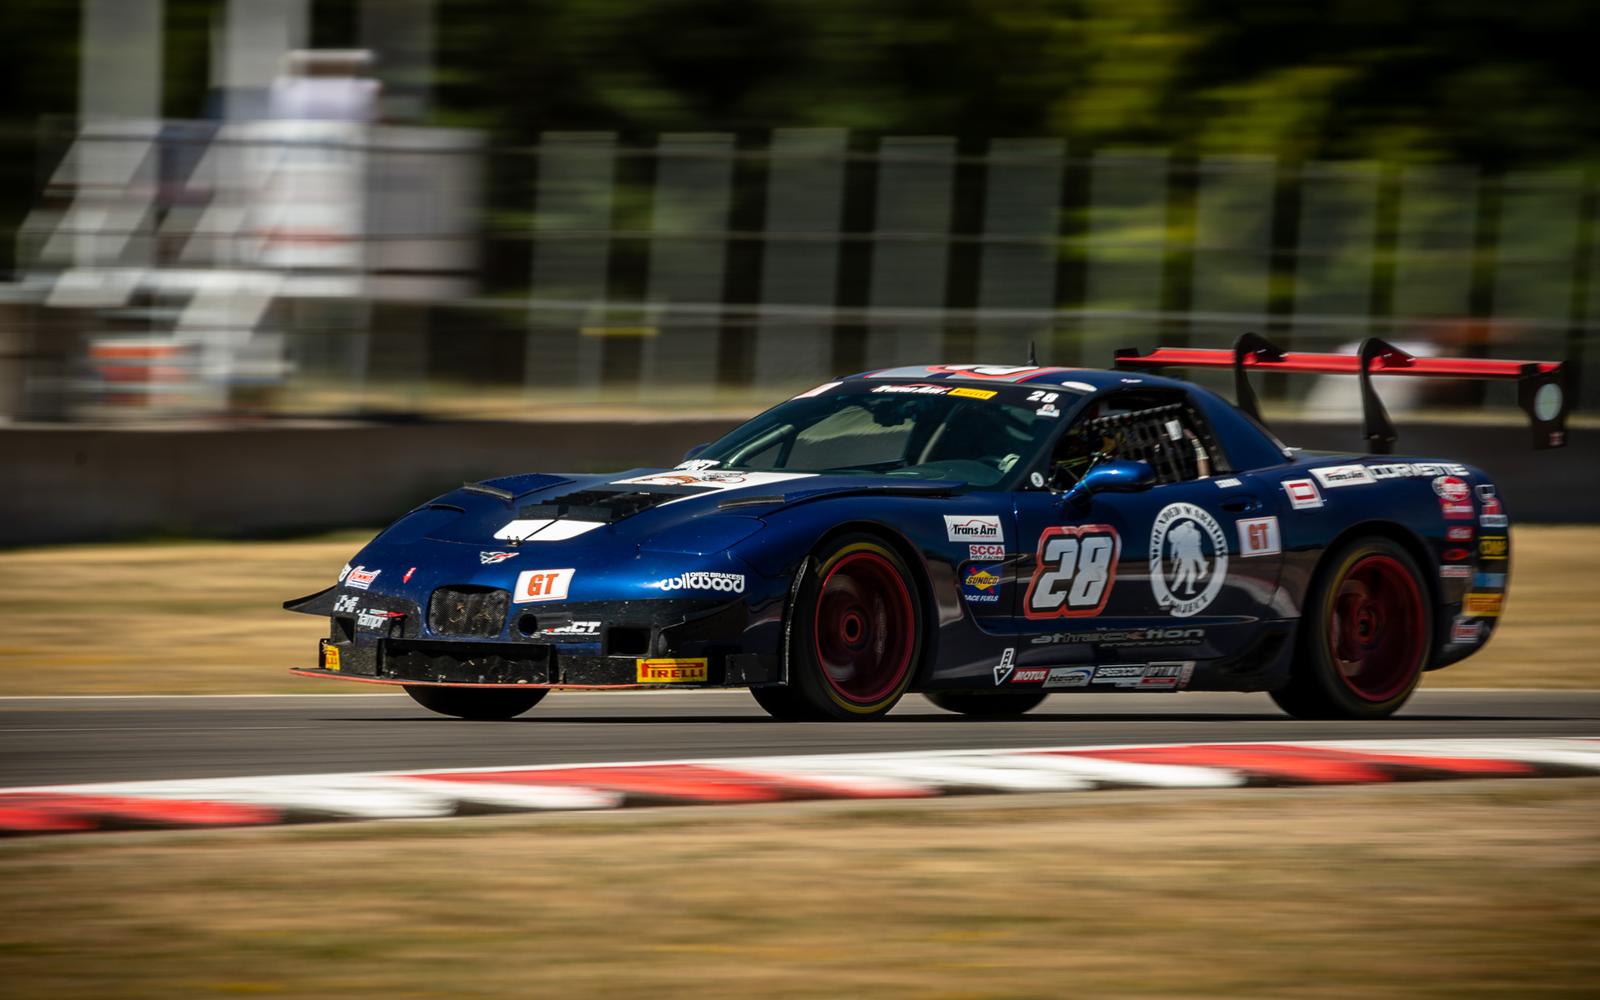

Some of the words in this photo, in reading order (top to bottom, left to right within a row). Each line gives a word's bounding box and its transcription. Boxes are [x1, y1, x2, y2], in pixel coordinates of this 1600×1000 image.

[1027, 390, 1059, 404] 28
[953, 524, 979, 535] Trans
[980, 525, 997, 535] Am
[1248, 523, 1269, 551] GT
[970, 545, 1004, 556] SCCA
[710, 572, 742, 580] BRAKES
[1029, 533, 1116, 612] 28
[527, 573, 560, 597] GT
[967, 576, 998, 585] SUNOCO
[641, 662, 704, 678] PIRELLI
[1013, 670, 1048, 681] MOTUL
